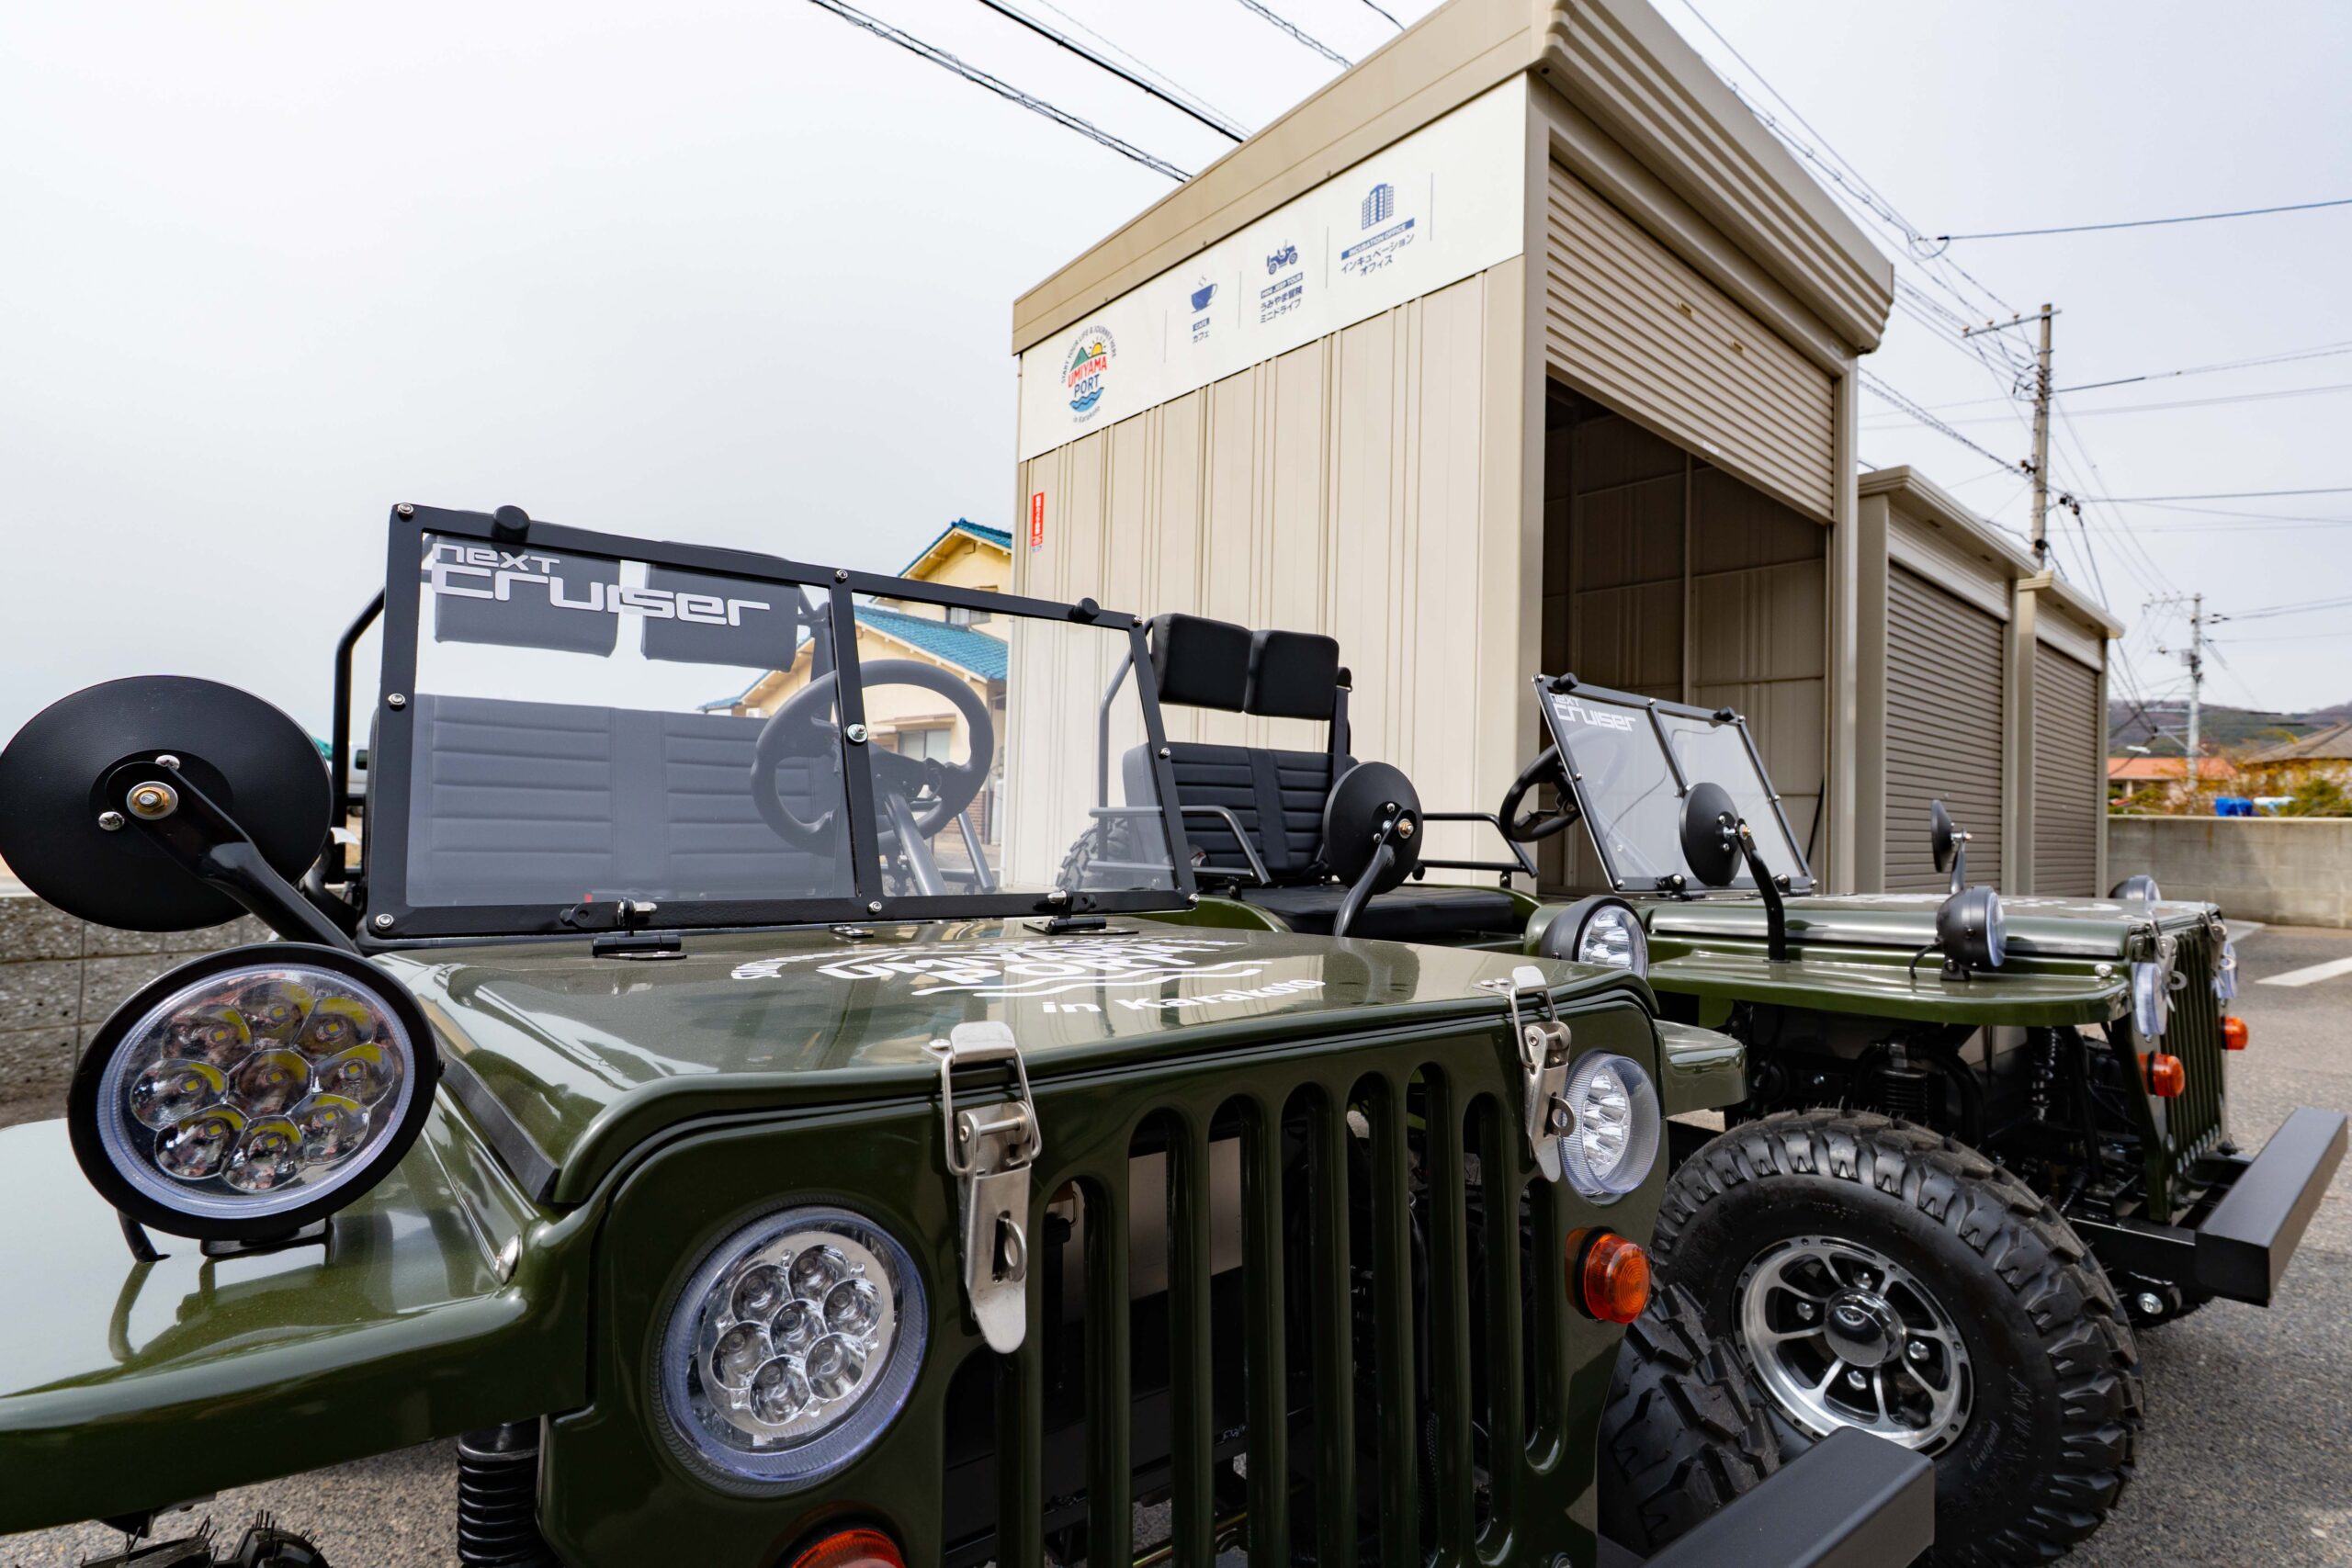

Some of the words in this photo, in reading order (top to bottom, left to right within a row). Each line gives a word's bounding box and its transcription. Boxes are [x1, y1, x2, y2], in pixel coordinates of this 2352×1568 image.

[1341, 233, 1415, 275] インキュベーション
[1360, 254, 1394, 277] オフィス
[1193, 331, 1210, 344] カフェ
[1068, 355, 1108, 389] UMIYAMA
[1074, 374, 1101, 398] PORT
[815, 944, 1220, 980] UMIYAMA
[926, 953, 1196, 985] PORT
[1042, 1001, 1102, 1014] in
[1114, 979, 1327, 1010] Karakoto
